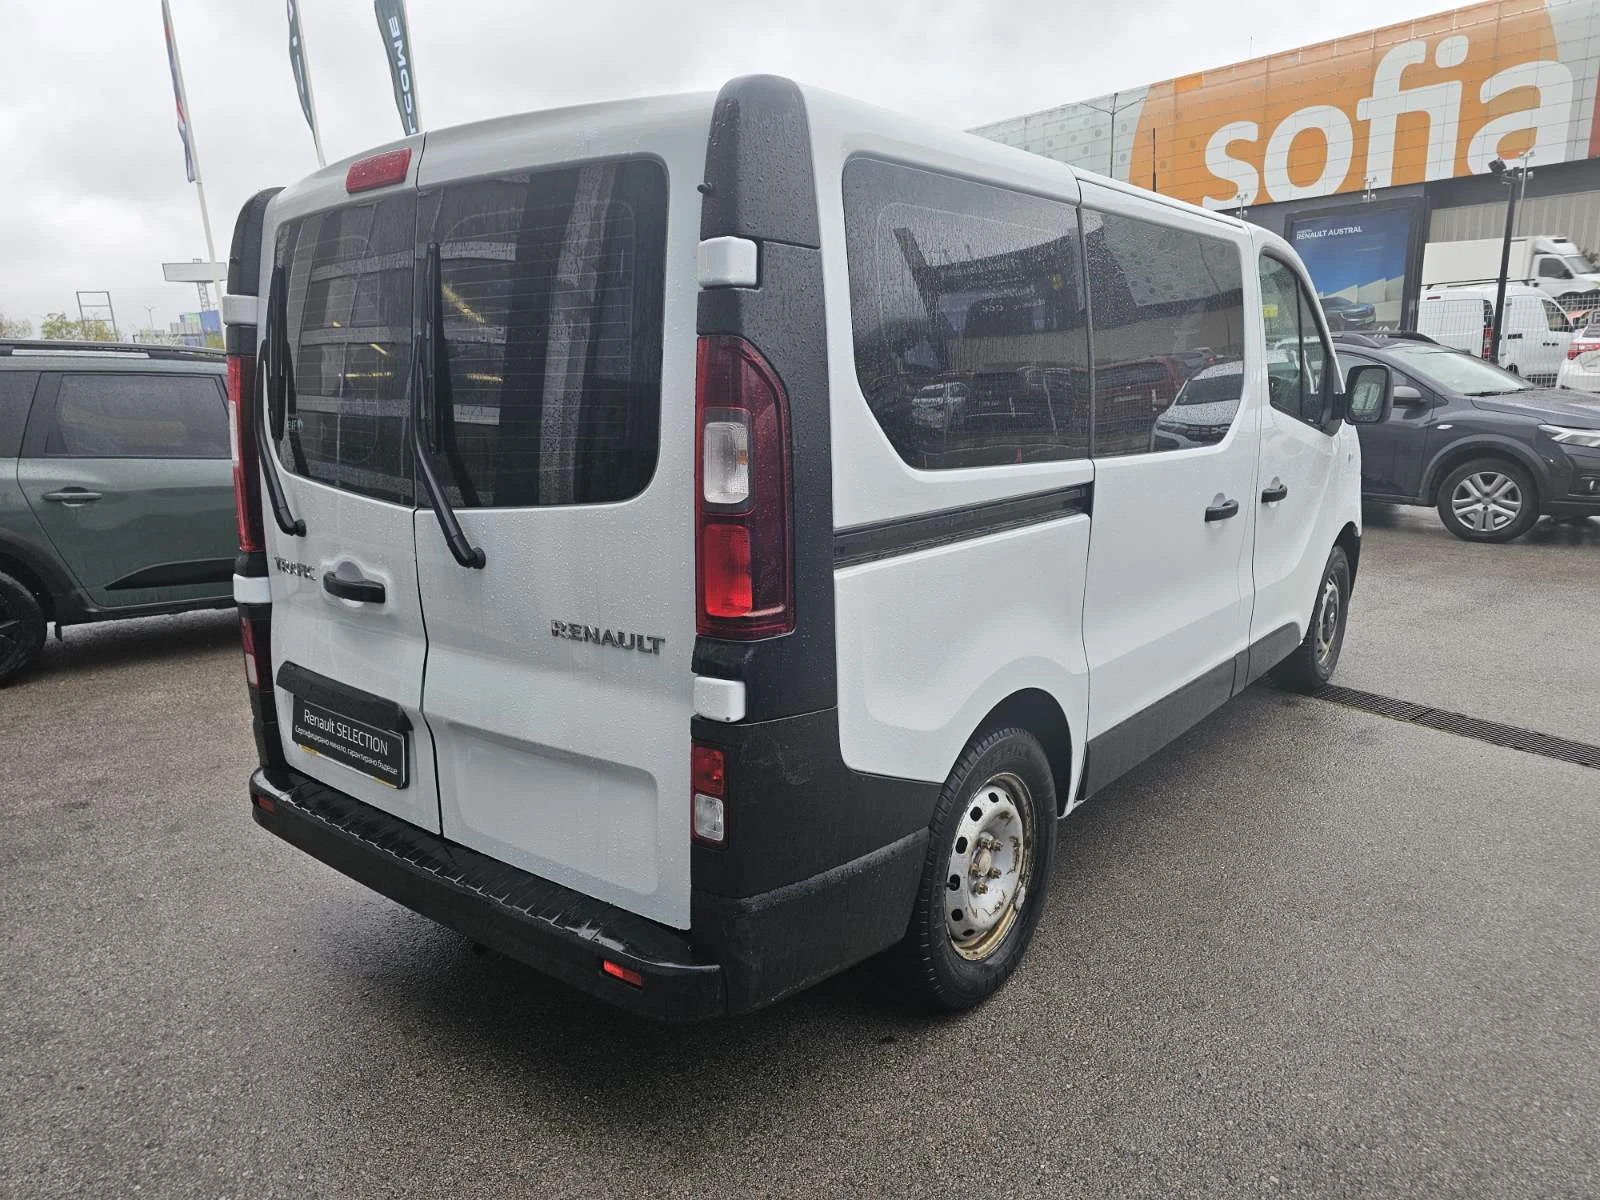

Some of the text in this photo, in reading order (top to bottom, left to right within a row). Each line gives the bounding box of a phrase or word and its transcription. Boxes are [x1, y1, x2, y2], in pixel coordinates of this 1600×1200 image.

[1202, 35, 1574, 211] sofia
[1296, 230, 1327, 240] RENAULT
[1328, 226, 1362, 236] AUSTRAL
[550, 619, 666, 655] RENAULT
[304, 709, 389, 756] Renault SELECTION
